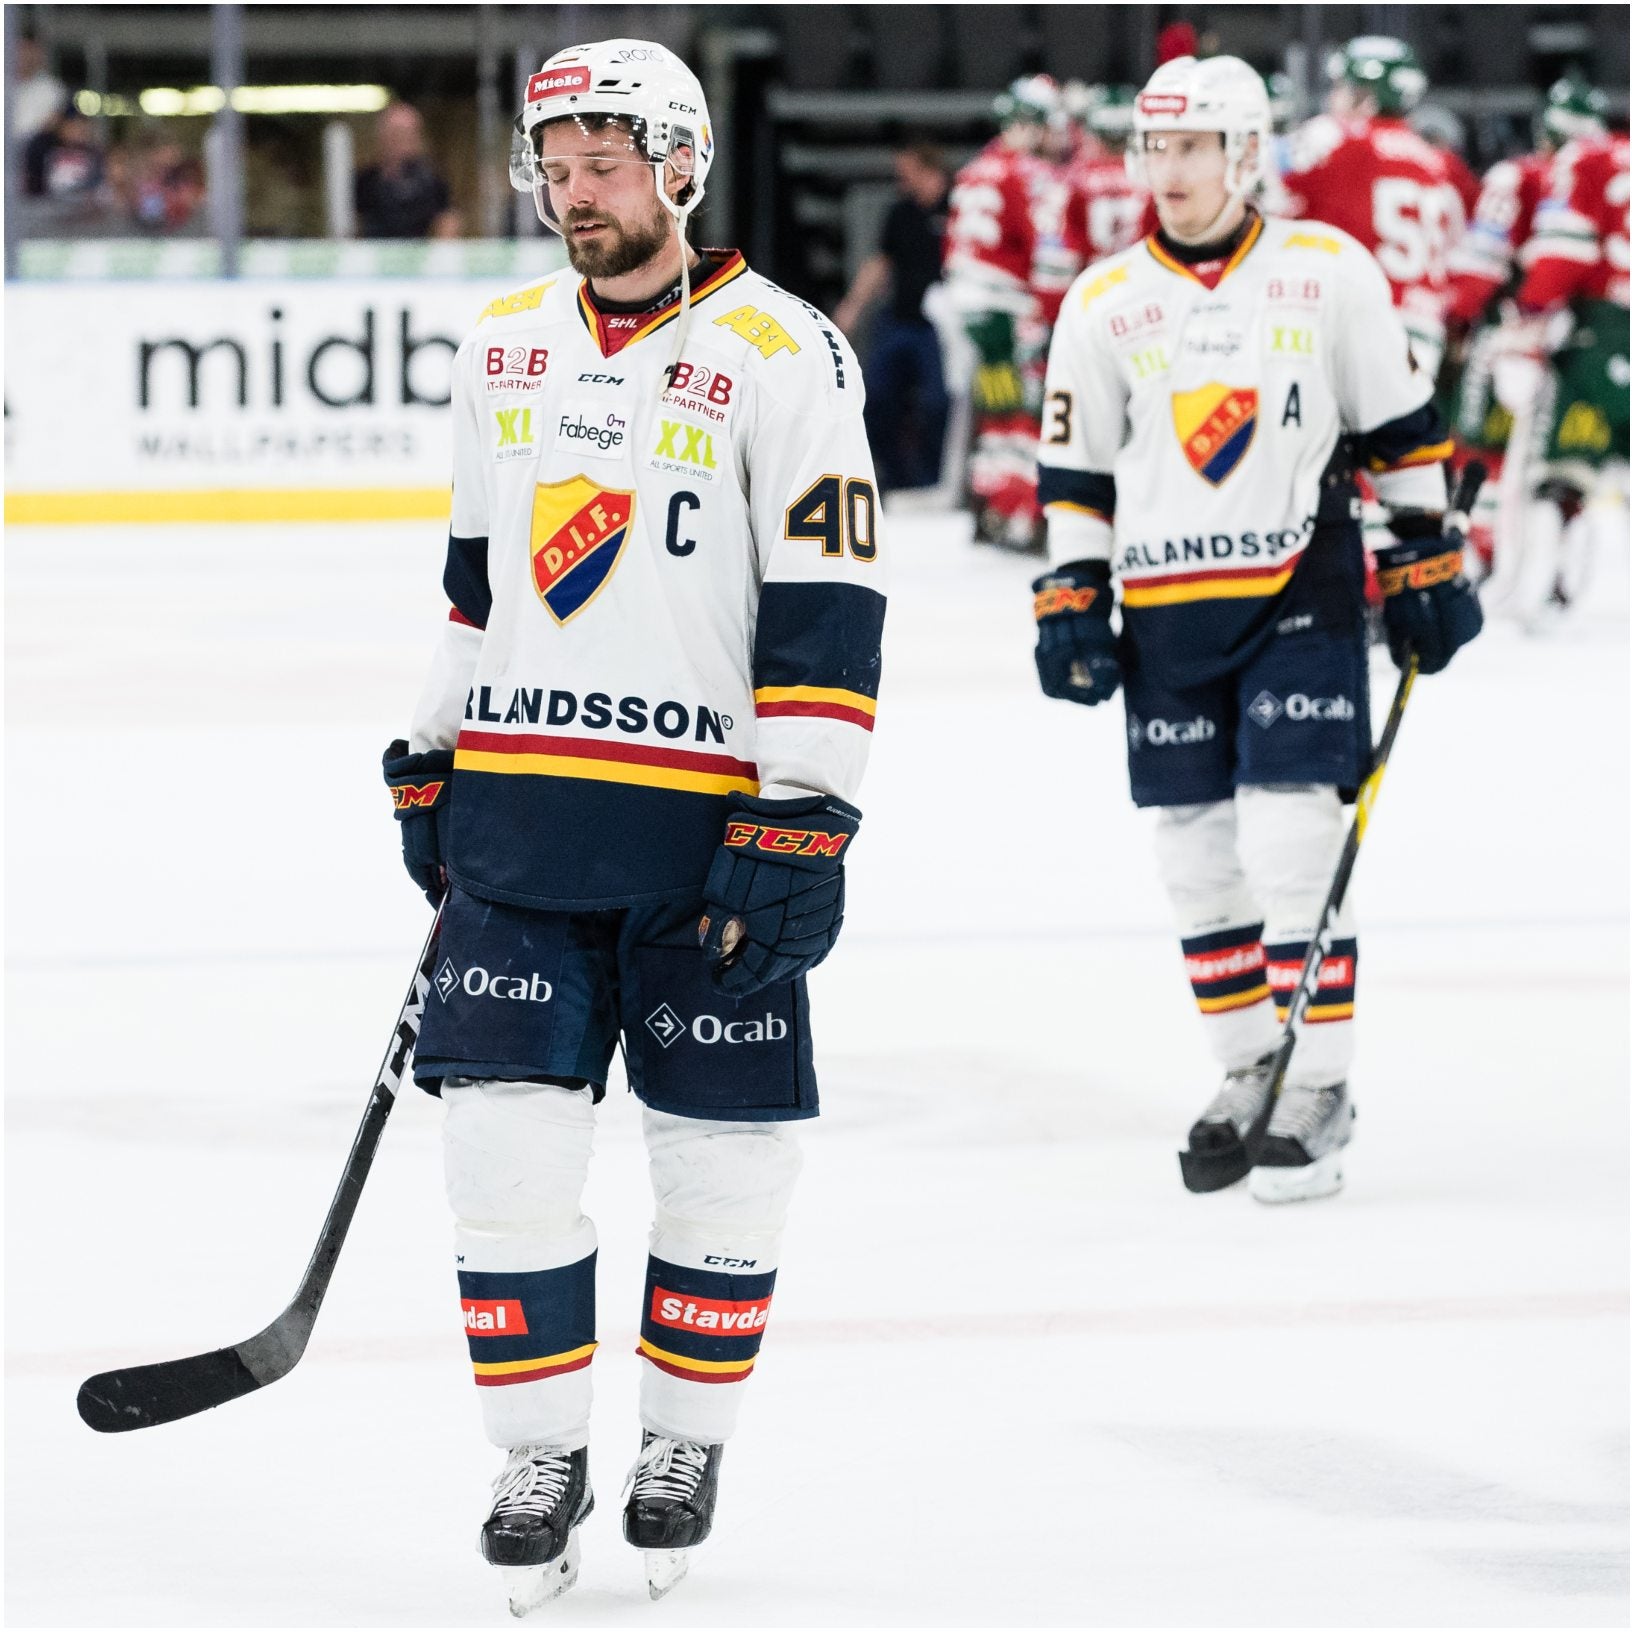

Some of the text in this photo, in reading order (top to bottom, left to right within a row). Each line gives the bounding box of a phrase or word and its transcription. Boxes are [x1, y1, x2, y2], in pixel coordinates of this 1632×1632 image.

[533, 74, 583, 93] Miele
[668, 101, 697, 115] CCM
[608, 317, 638, 329] SHL
[712, 304, 801, 360] ABT
[487, 347, 549, 376] B2B
[578, 373, 625, 386] CCM
[671, 362, 733, 405] B2B
[1281, 382, 1302, 428] A
[559, 415, 623, 449] Fabege
[654, 420, 717, 469] XXL
[663, 463, 688, 475] SPORTS
[689, 468, 713, 481] UNITED
[665, 490, 701, 557] C
[784, 474, 878, 562] 40
[542, 502, 622, 575] D.I.F.
[1285, 693, 1355, 721] Ocab
[1147, 715, 1217, 747] Ocab
[723, 822, 850, 858] CCM
[462, 966, 553, 1003] Ocab
[691, 1012, 788, 1046] Ocab
[703, 1253, 759, 1269] CCM
